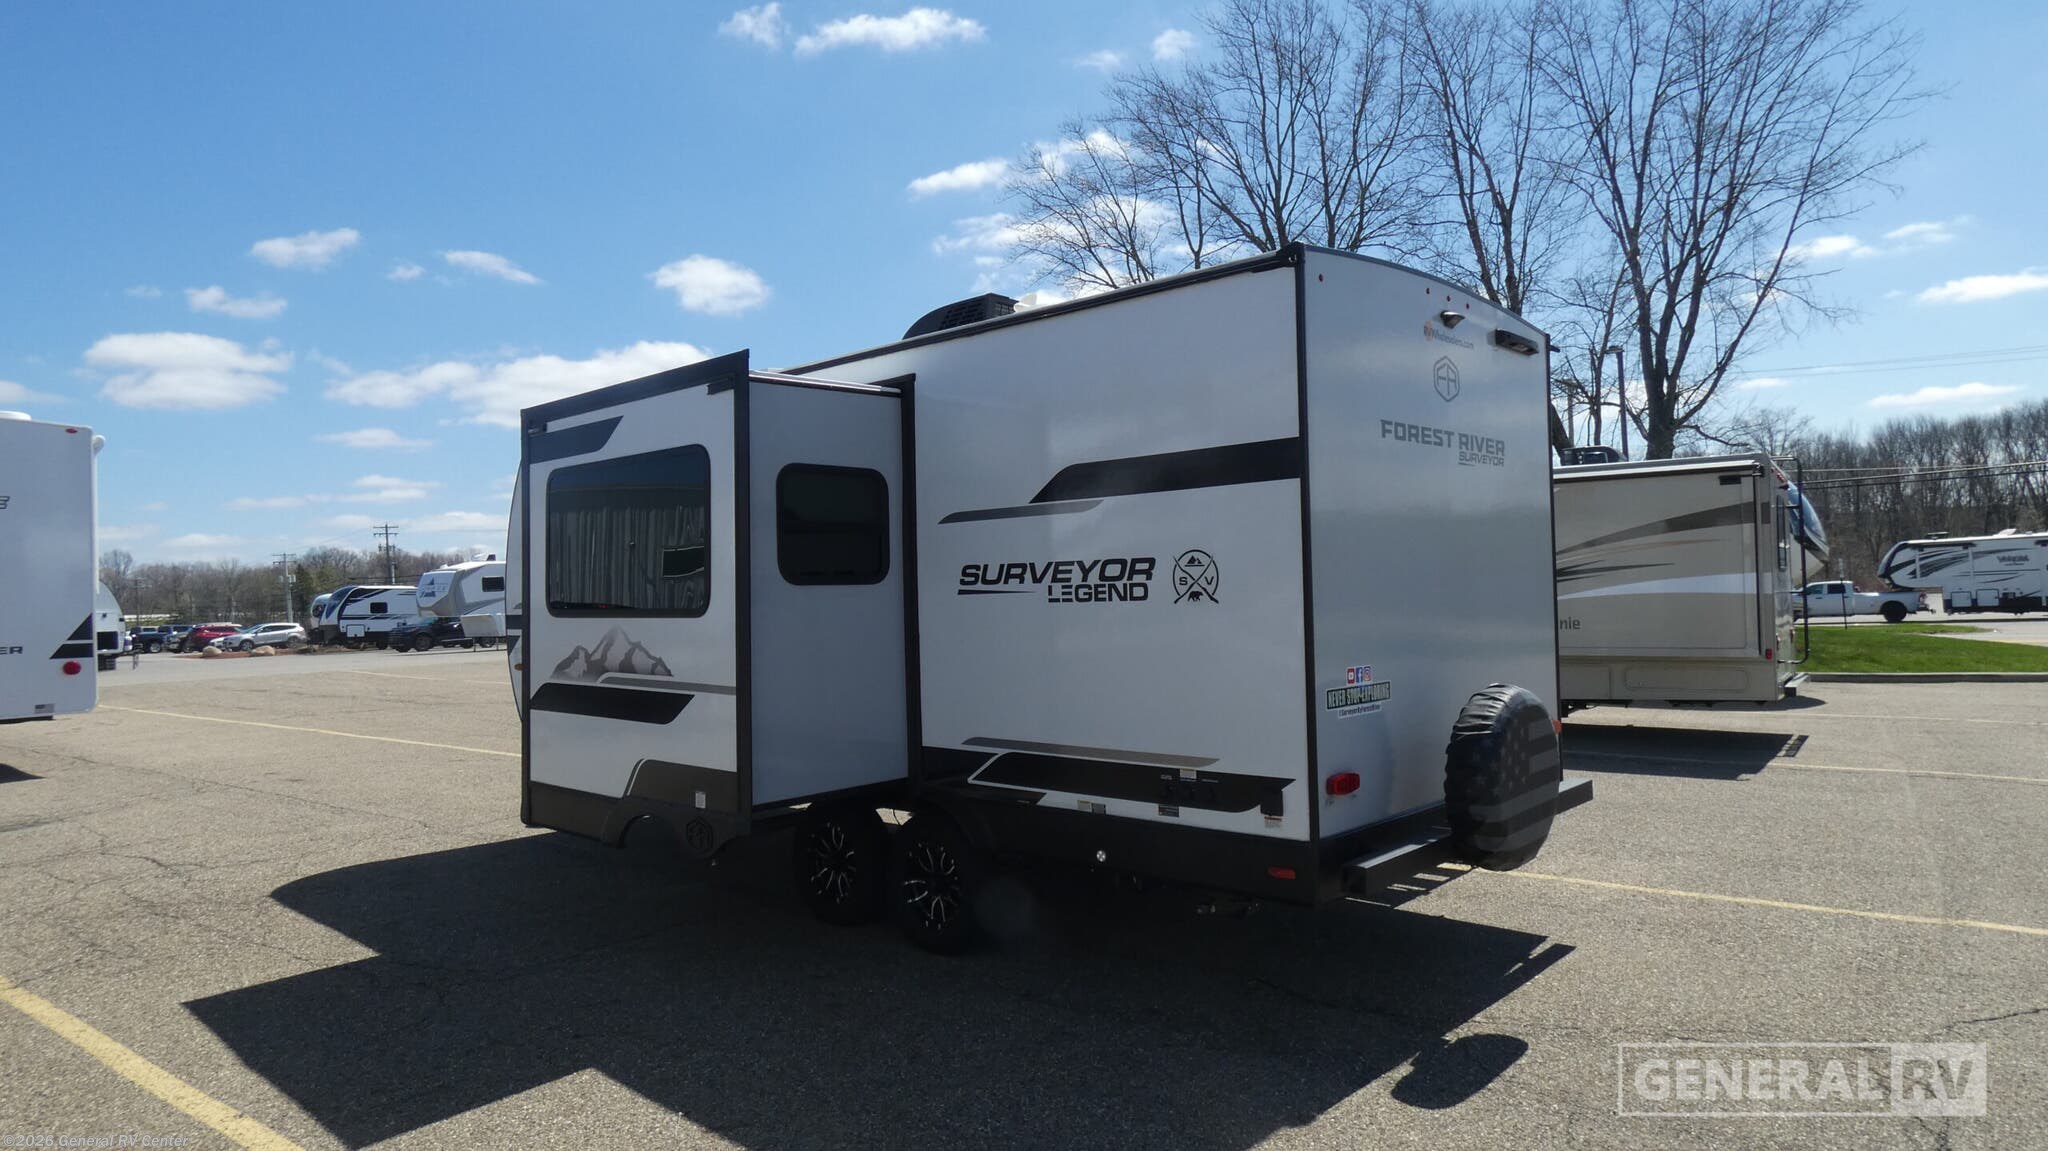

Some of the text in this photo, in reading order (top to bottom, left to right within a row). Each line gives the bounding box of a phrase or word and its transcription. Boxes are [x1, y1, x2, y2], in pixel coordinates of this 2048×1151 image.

[1380, 419, 1505, 456] FOREST RIVER
[1458, 451, 1505, 467] SURVEYOR
[959, 556, 1156, 586] SURVEYOR
[1179, 576, 1214, 586] S V
[1047, 582, 1149, 603] LEGEND
